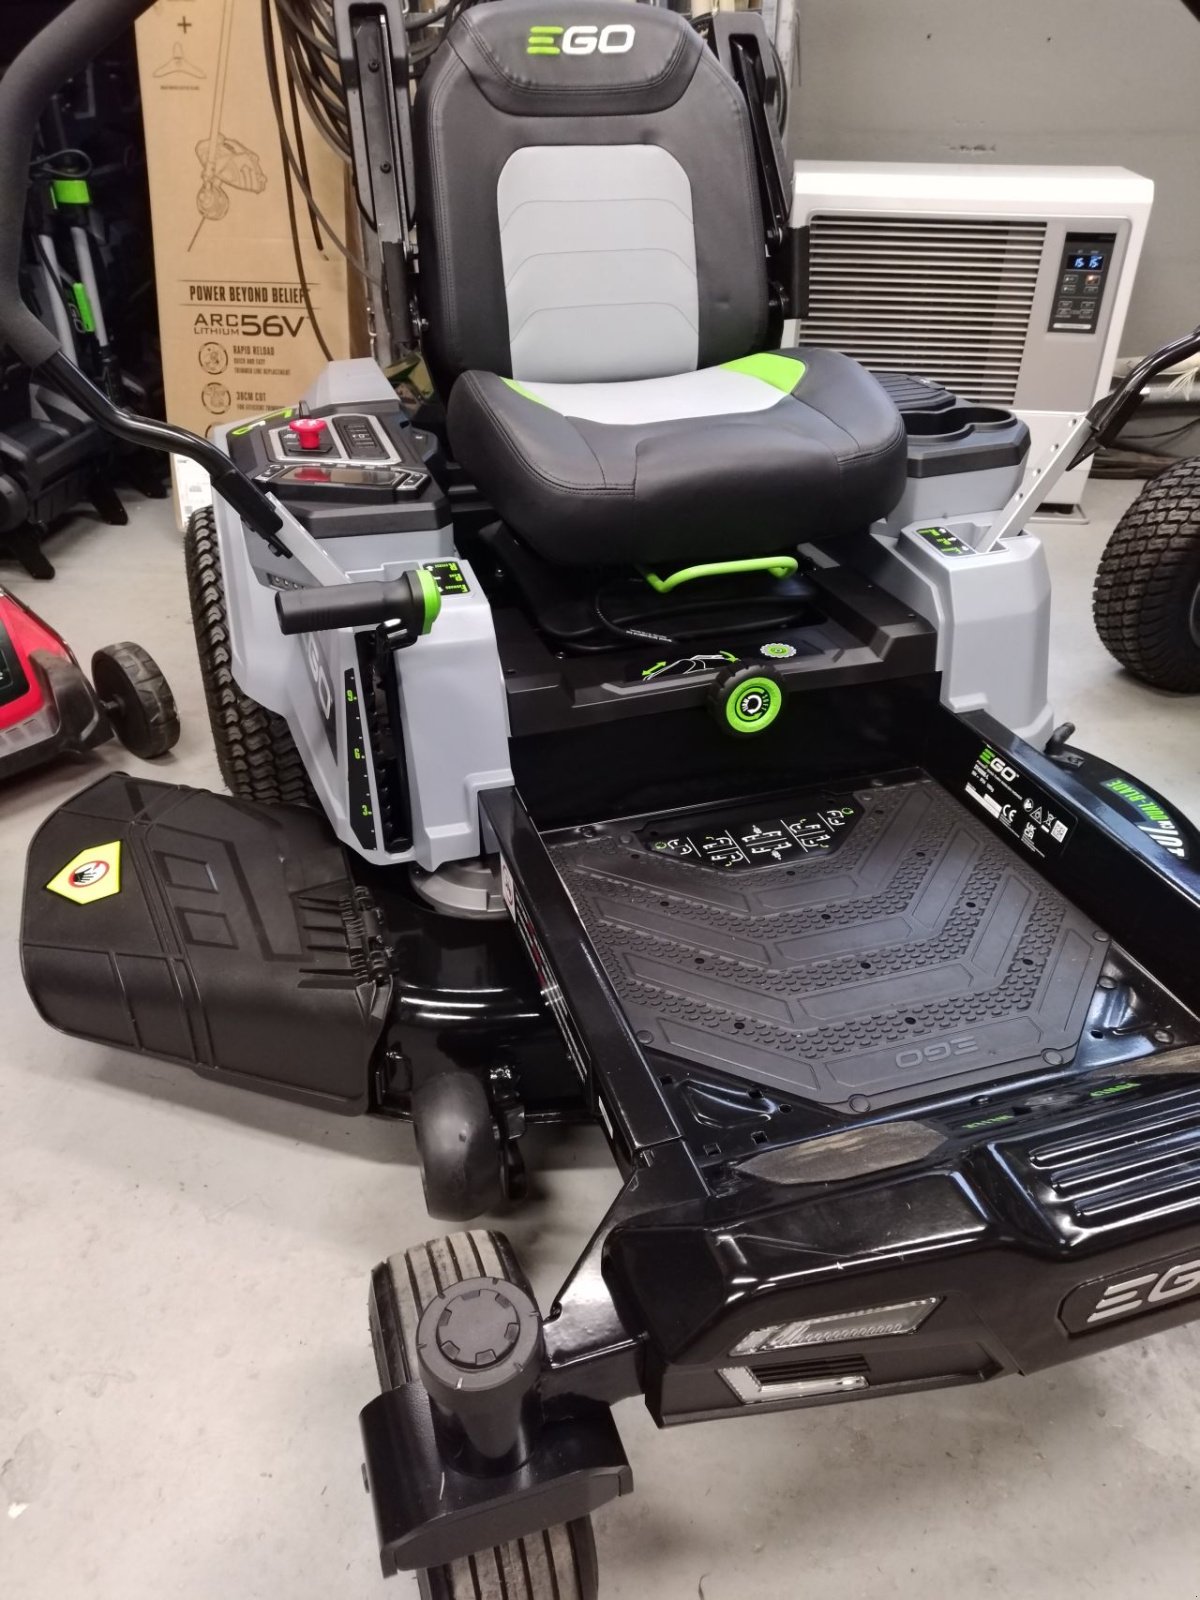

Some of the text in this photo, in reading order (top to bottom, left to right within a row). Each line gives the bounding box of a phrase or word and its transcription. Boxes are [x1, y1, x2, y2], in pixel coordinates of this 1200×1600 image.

[526, 24, 635, 55] EGO
[189, 285, 225, 302] POWER
[229, 286, 268, 303] BEYOND
[194, 312, 304, 338] ARC 56V
[194, 327, 240, 336] LITHIUM
[252, 346, 275, 356] RELOAD
[303, 633, 334, 720] GO
[353, 748, 361, 760] 6
[979, 747, 1018, 782] EGO
[361, 804, 369, 816] 3
[1106, 779, 1170, 821] DUAL-BLADE
[895, 1036, 979, 1069] EGO
[1087, 1259, 1200, 1323] EG
